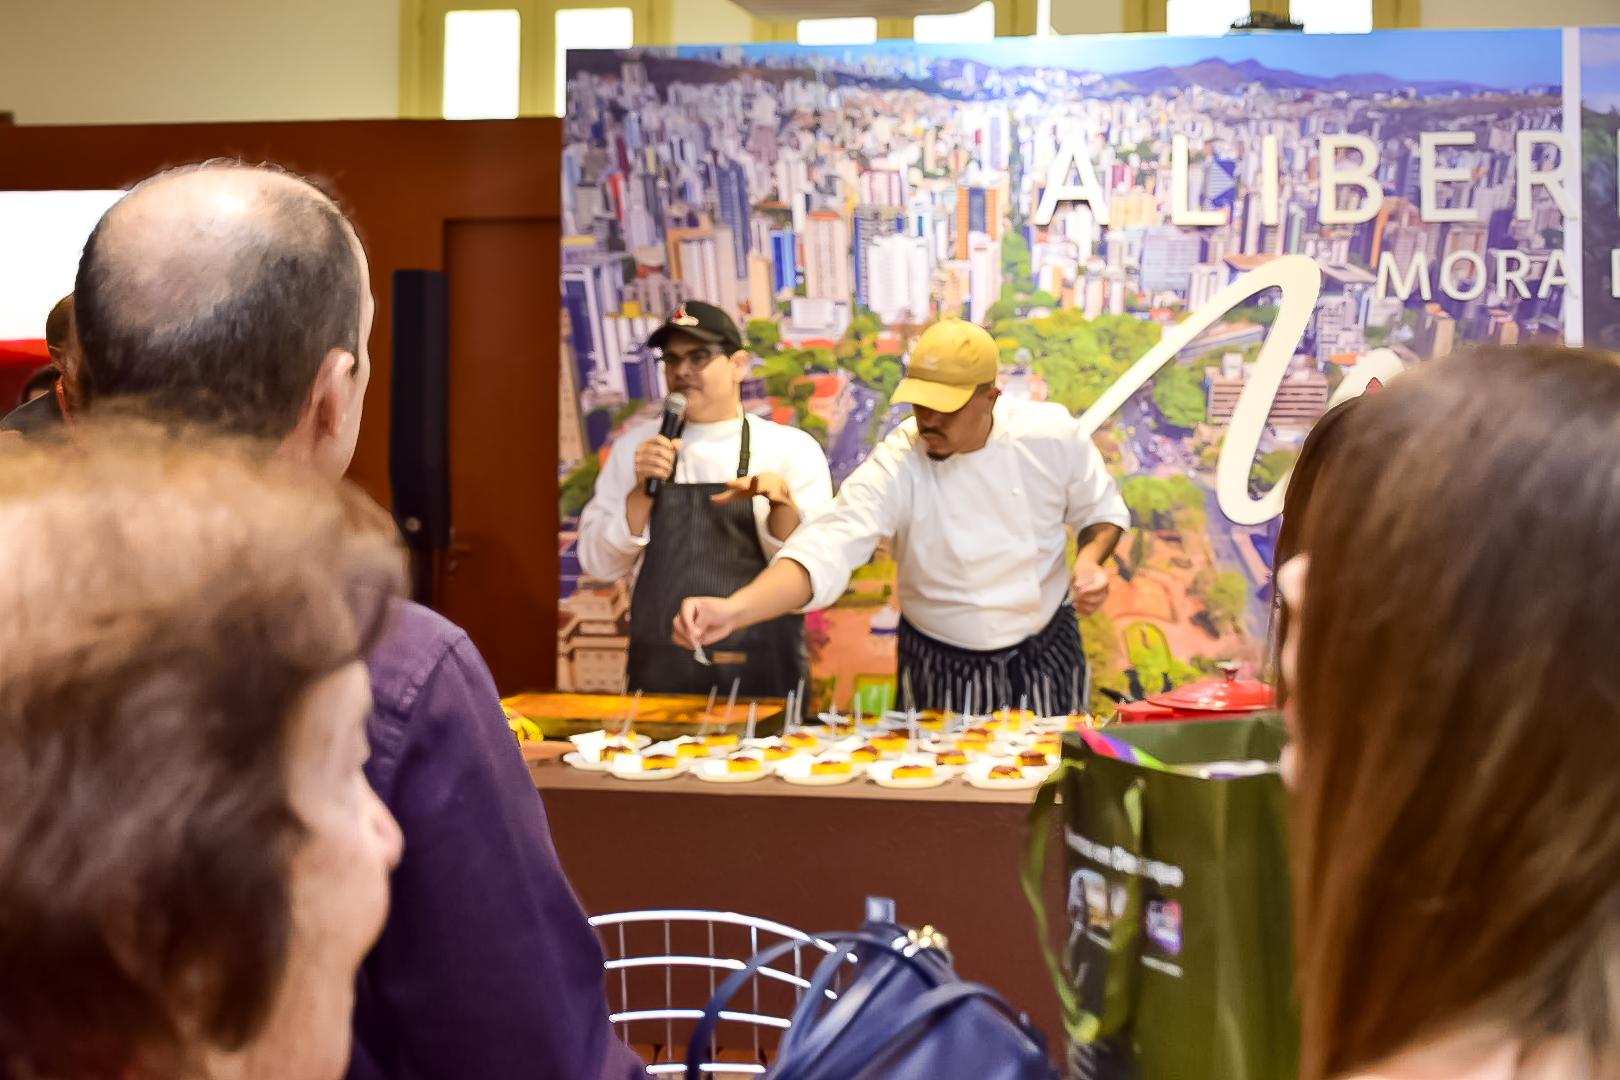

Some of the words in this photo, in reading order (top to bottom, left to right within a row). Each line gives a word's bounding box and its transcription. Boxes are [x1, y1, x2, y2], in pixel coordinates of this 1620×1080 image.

[1036, 134, 1110, 226] A
[1172, 129, 1620, 226] LIBER
[1376, 248, 1578, 301] MORA
